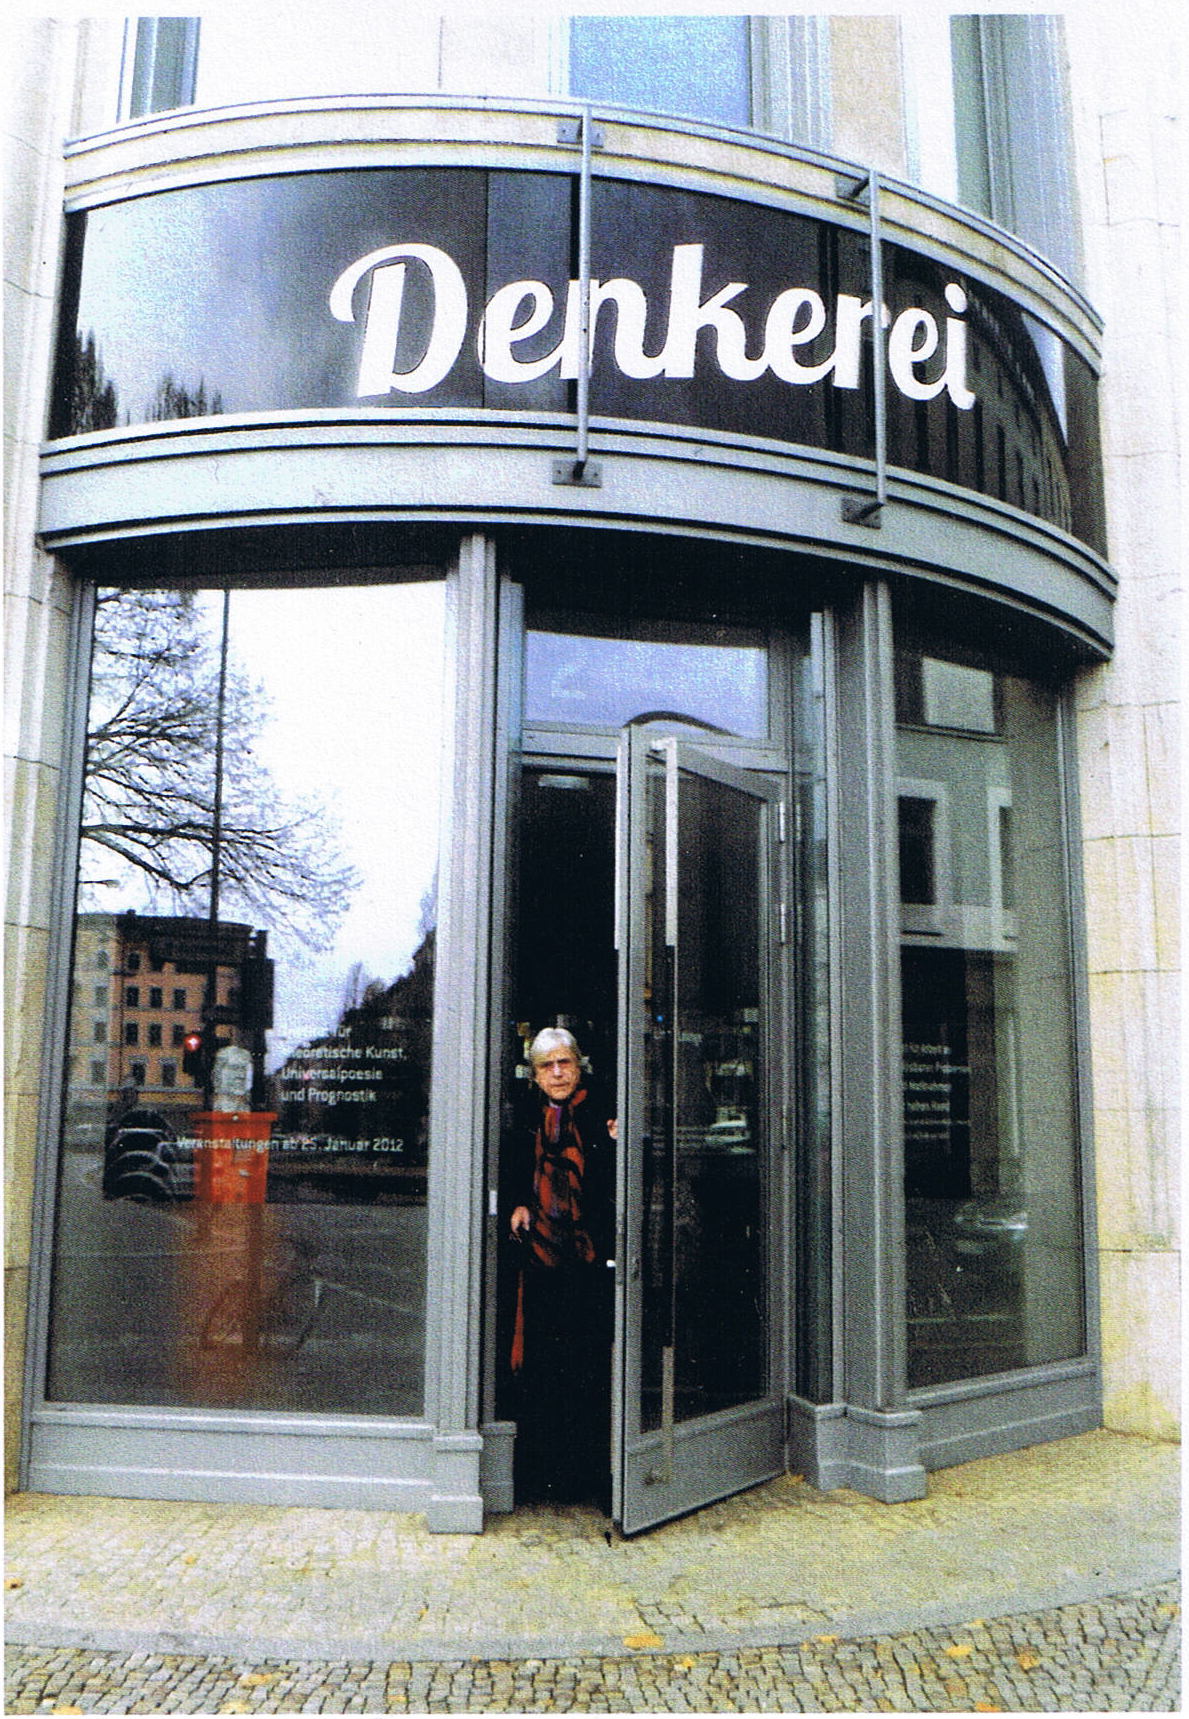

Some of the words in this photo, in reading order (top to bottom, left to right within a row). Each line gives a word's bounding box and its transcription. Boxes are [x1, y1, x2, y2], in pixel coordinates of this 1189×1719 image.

[329, 243, 975, 411] Denkerei
[365, 1046, 407, 1060] Kunst,
[281, 1066, 383, 1082] Universalpoesie
[280, 1088, 306, 1102] und
[308, 1087, 377, 1106] Prognostik
[176, 1136, 279, 1153] Veranstaltungen
[282, 1136, 298, 1151] ab
[324, 1136, 371, 1151] Januar
[373, 1137, 404, 1152] 2012
